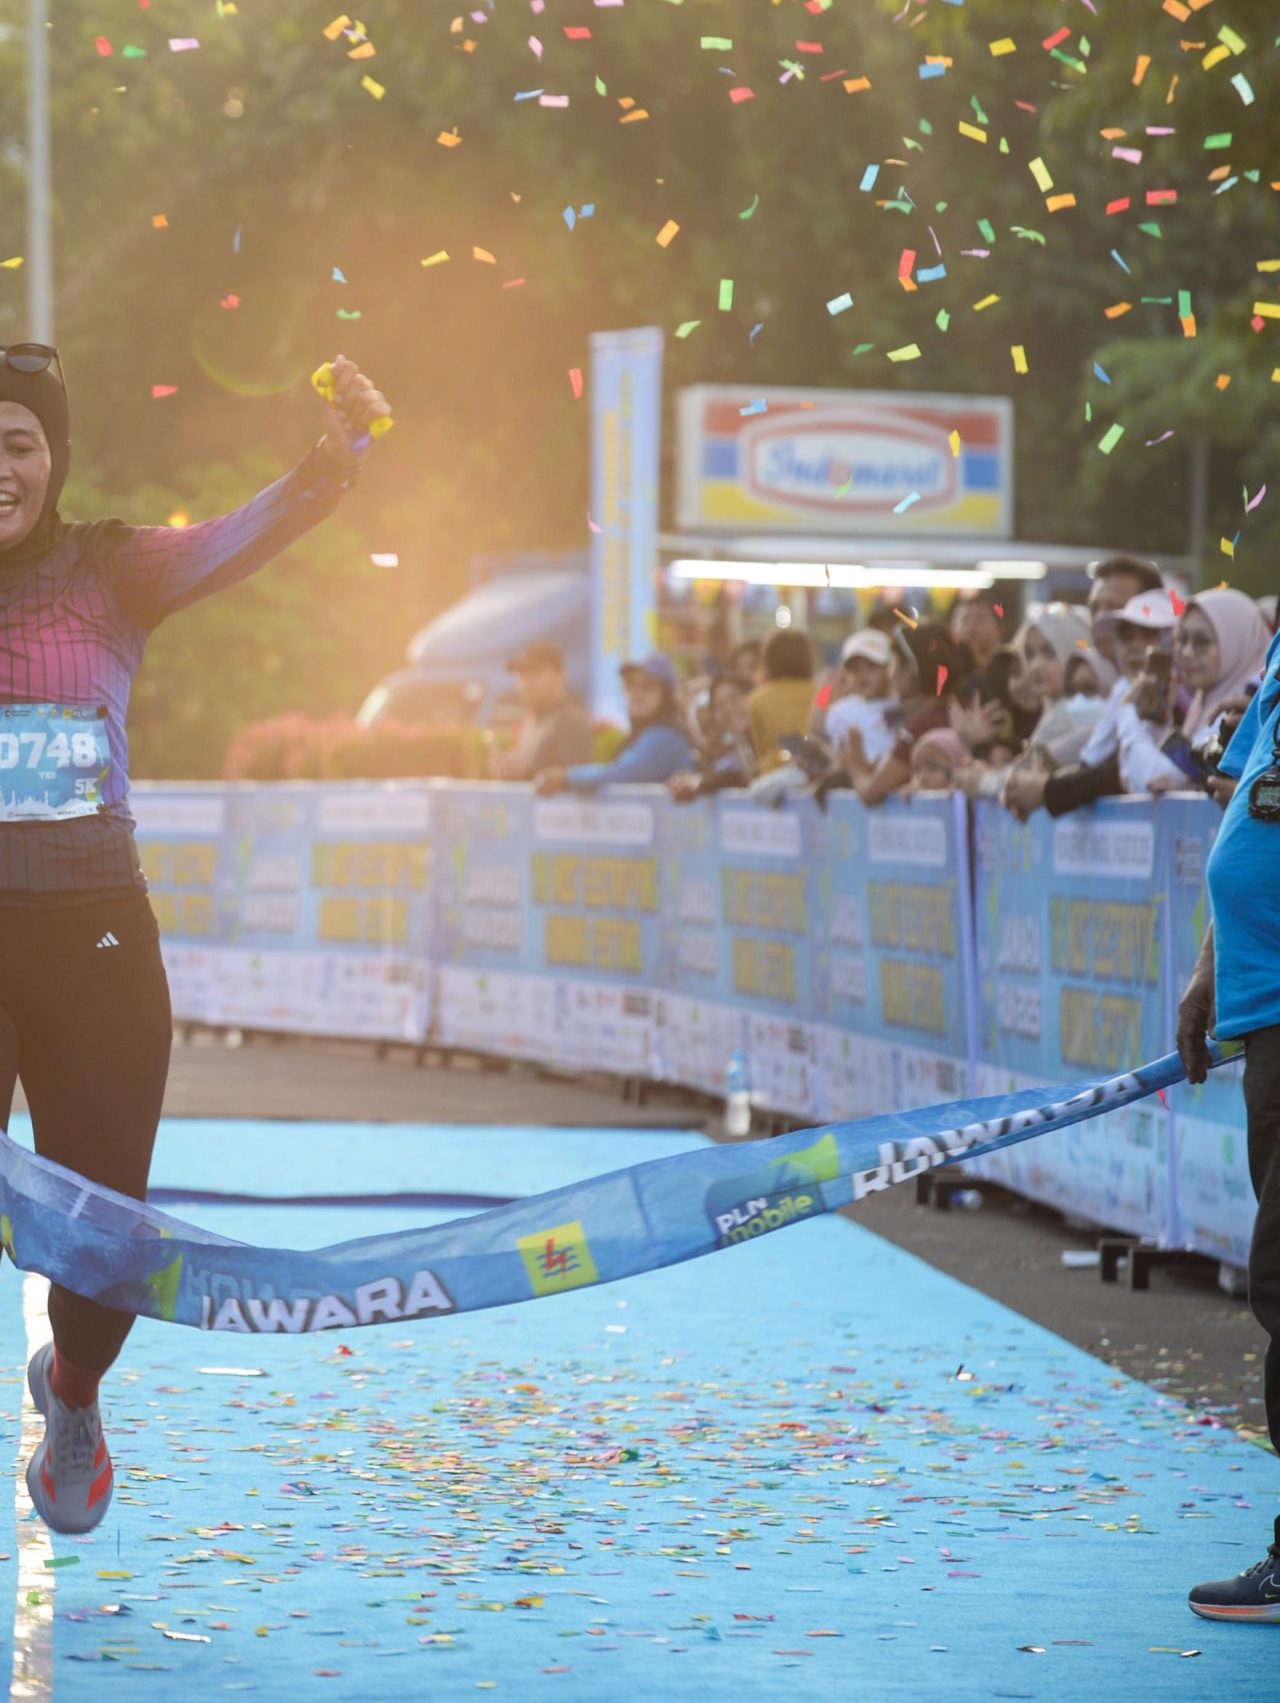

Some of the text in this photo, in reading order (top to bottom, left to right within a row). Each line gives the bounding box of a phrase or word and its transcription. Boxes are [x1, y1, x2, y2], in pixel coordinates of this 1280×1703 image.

[74, 777, 98, 795] 5K
[715, 1197, 768, 1235] PLN
[720, 1195, 813, 1246] mobile
